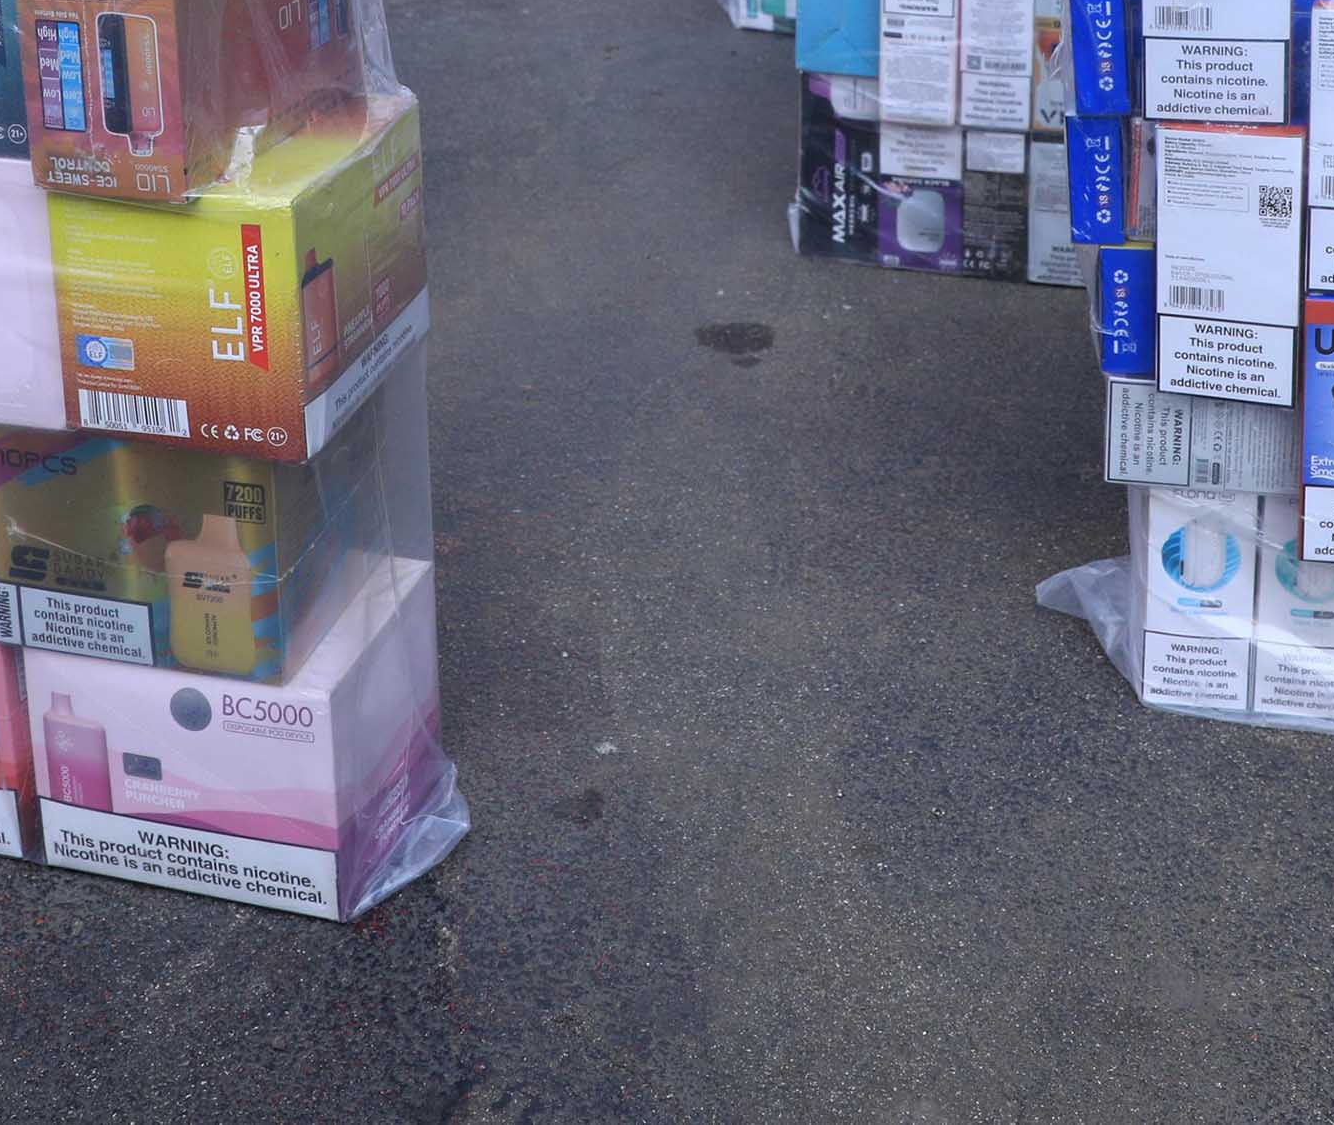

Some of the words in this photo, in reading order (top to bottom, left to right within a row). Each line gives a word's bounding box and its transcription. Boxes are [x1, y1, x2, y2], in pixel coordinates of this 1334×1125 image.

[37, 25, 58, 42] High
[47, 171, 118, 188] ICE-SWEET
[246, 244, 260, 289] ULTRA
[250, 291, 262, 323] 7000
[209, 287, 245, 362] ELF
[1194, 323, 1258, 340] WARNING:
[251, 327, 265, 353] VPR
[1188, 336, 1215, 349] This
[1216, 341, 1263, 355] product
[1174, 351, 1225, 364] contains
[1227, 355, 1277, 370] nicotine.
[1186, 363, 1235, 380] Nicotine
[1236, 369, 1248, 381] is
[1249, 373, 1265, 383] an
[1170, 377, 1223, 392] addictive
[1224, 383, 1281, 399] chemical.
[1172, 409, 1183, 466] WARNING:
[1, 448, 78, 476] 10PCS
[227, 483, 264, 503] 7200
[227, 504, 263, 521] PUFFS
[45, 596, 72, 612] This
[73, 603, 120, 620] product
[33, 609, 84, 626] contains
[86, 616, 135, 634] nicotine
[43, 620, 95, 640] Nicotine
[96, 629, 108, 642] is
[109, 633, 125, 644] an
[31, 632, 85, 650] addictive
[87, 640, 146, 659] chemical.
[222, 694, 314, 727] BC5000
[124, 779, 200, 801] CRANBERRY
[125, 791, 186, 810] PUNCHER
[138, 830, 229, 859] WARNING:
[60, 829, 95, 848] This
[99, 839, 162, 862] product
[167, 850, 238, 875] contains
[243, 865, 316, 889] nicotine.
[54, 842, 120, 866] Nicotine
[123, 856, 139, 870] is
[143, 861, 163, 874] an
[166, 862, 241, 889] addictive
[246, 878, 327, 905] chemical.
